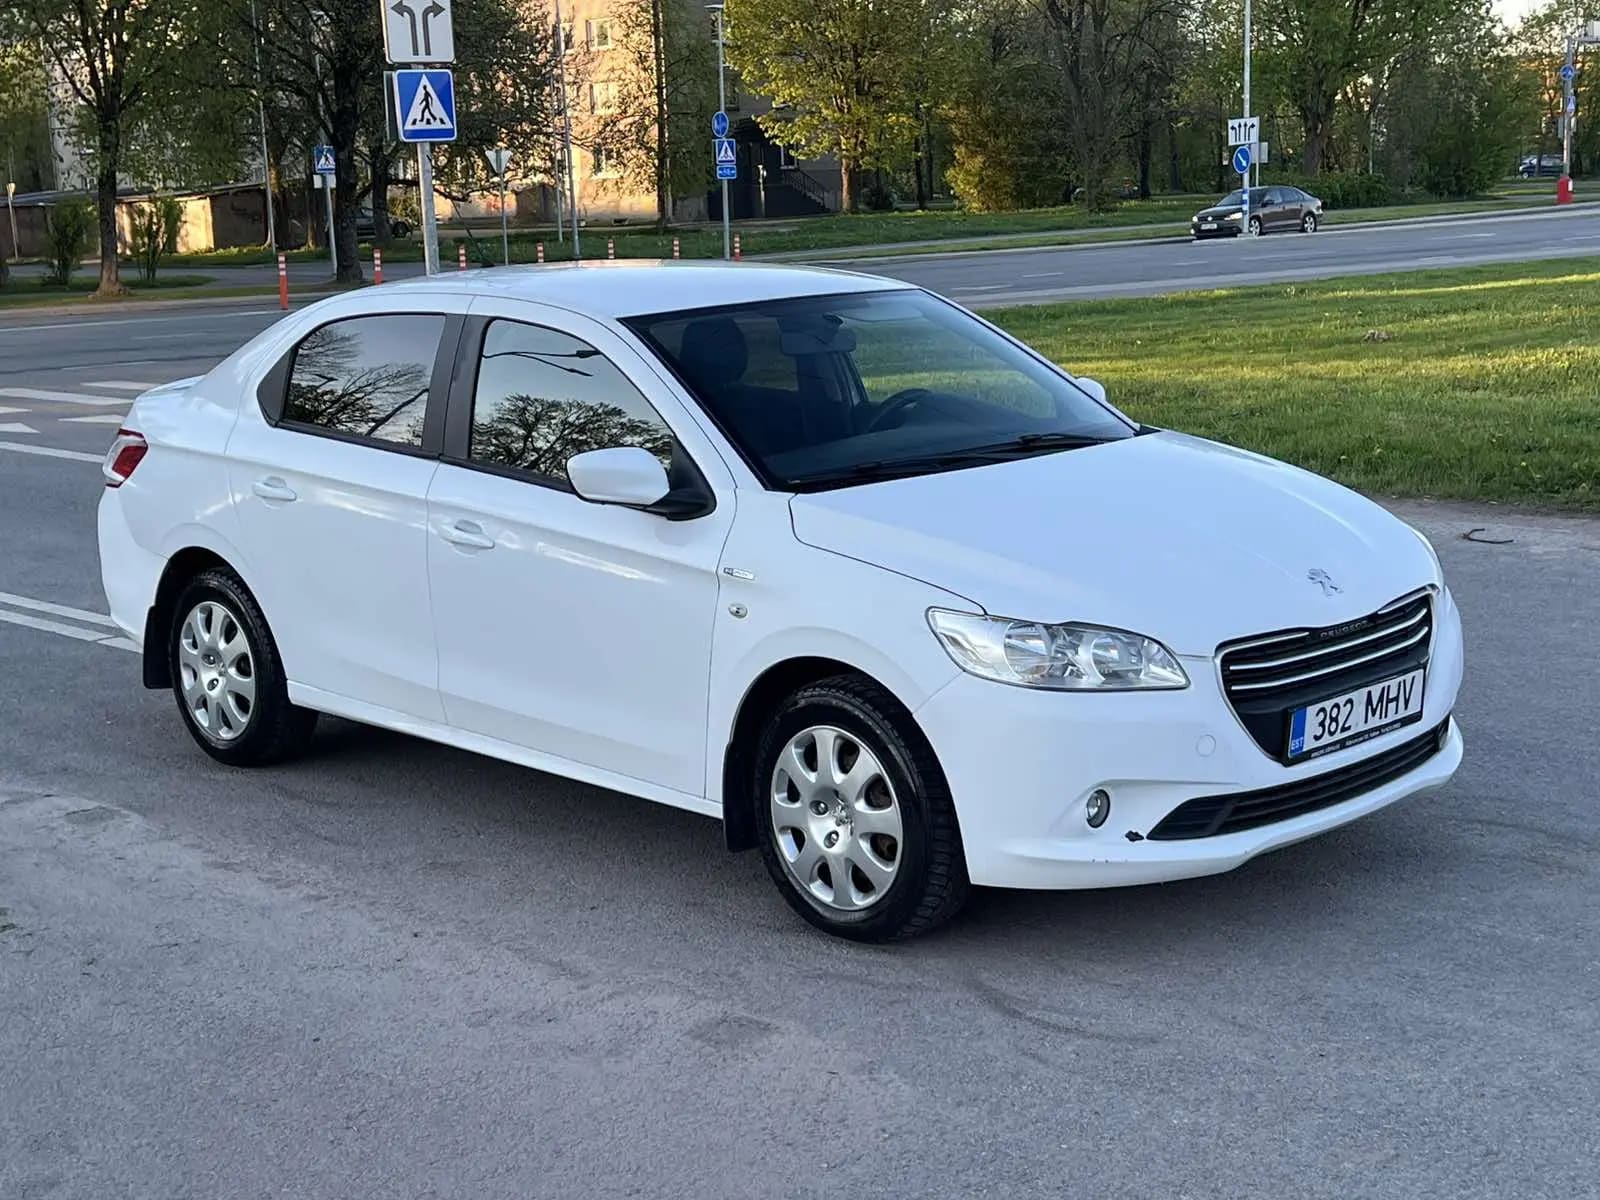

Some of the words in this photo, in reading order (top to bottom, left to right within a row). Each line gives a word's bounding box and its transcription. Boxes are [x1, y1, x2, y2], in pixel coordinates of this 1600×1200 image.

[1320, 620, 1368, 640] PEUGEOT
[1313, 697, 1354, 742] 382
[1364, 675, 1416, 725] MHV
[1291, 736, 1304, 750] EST
